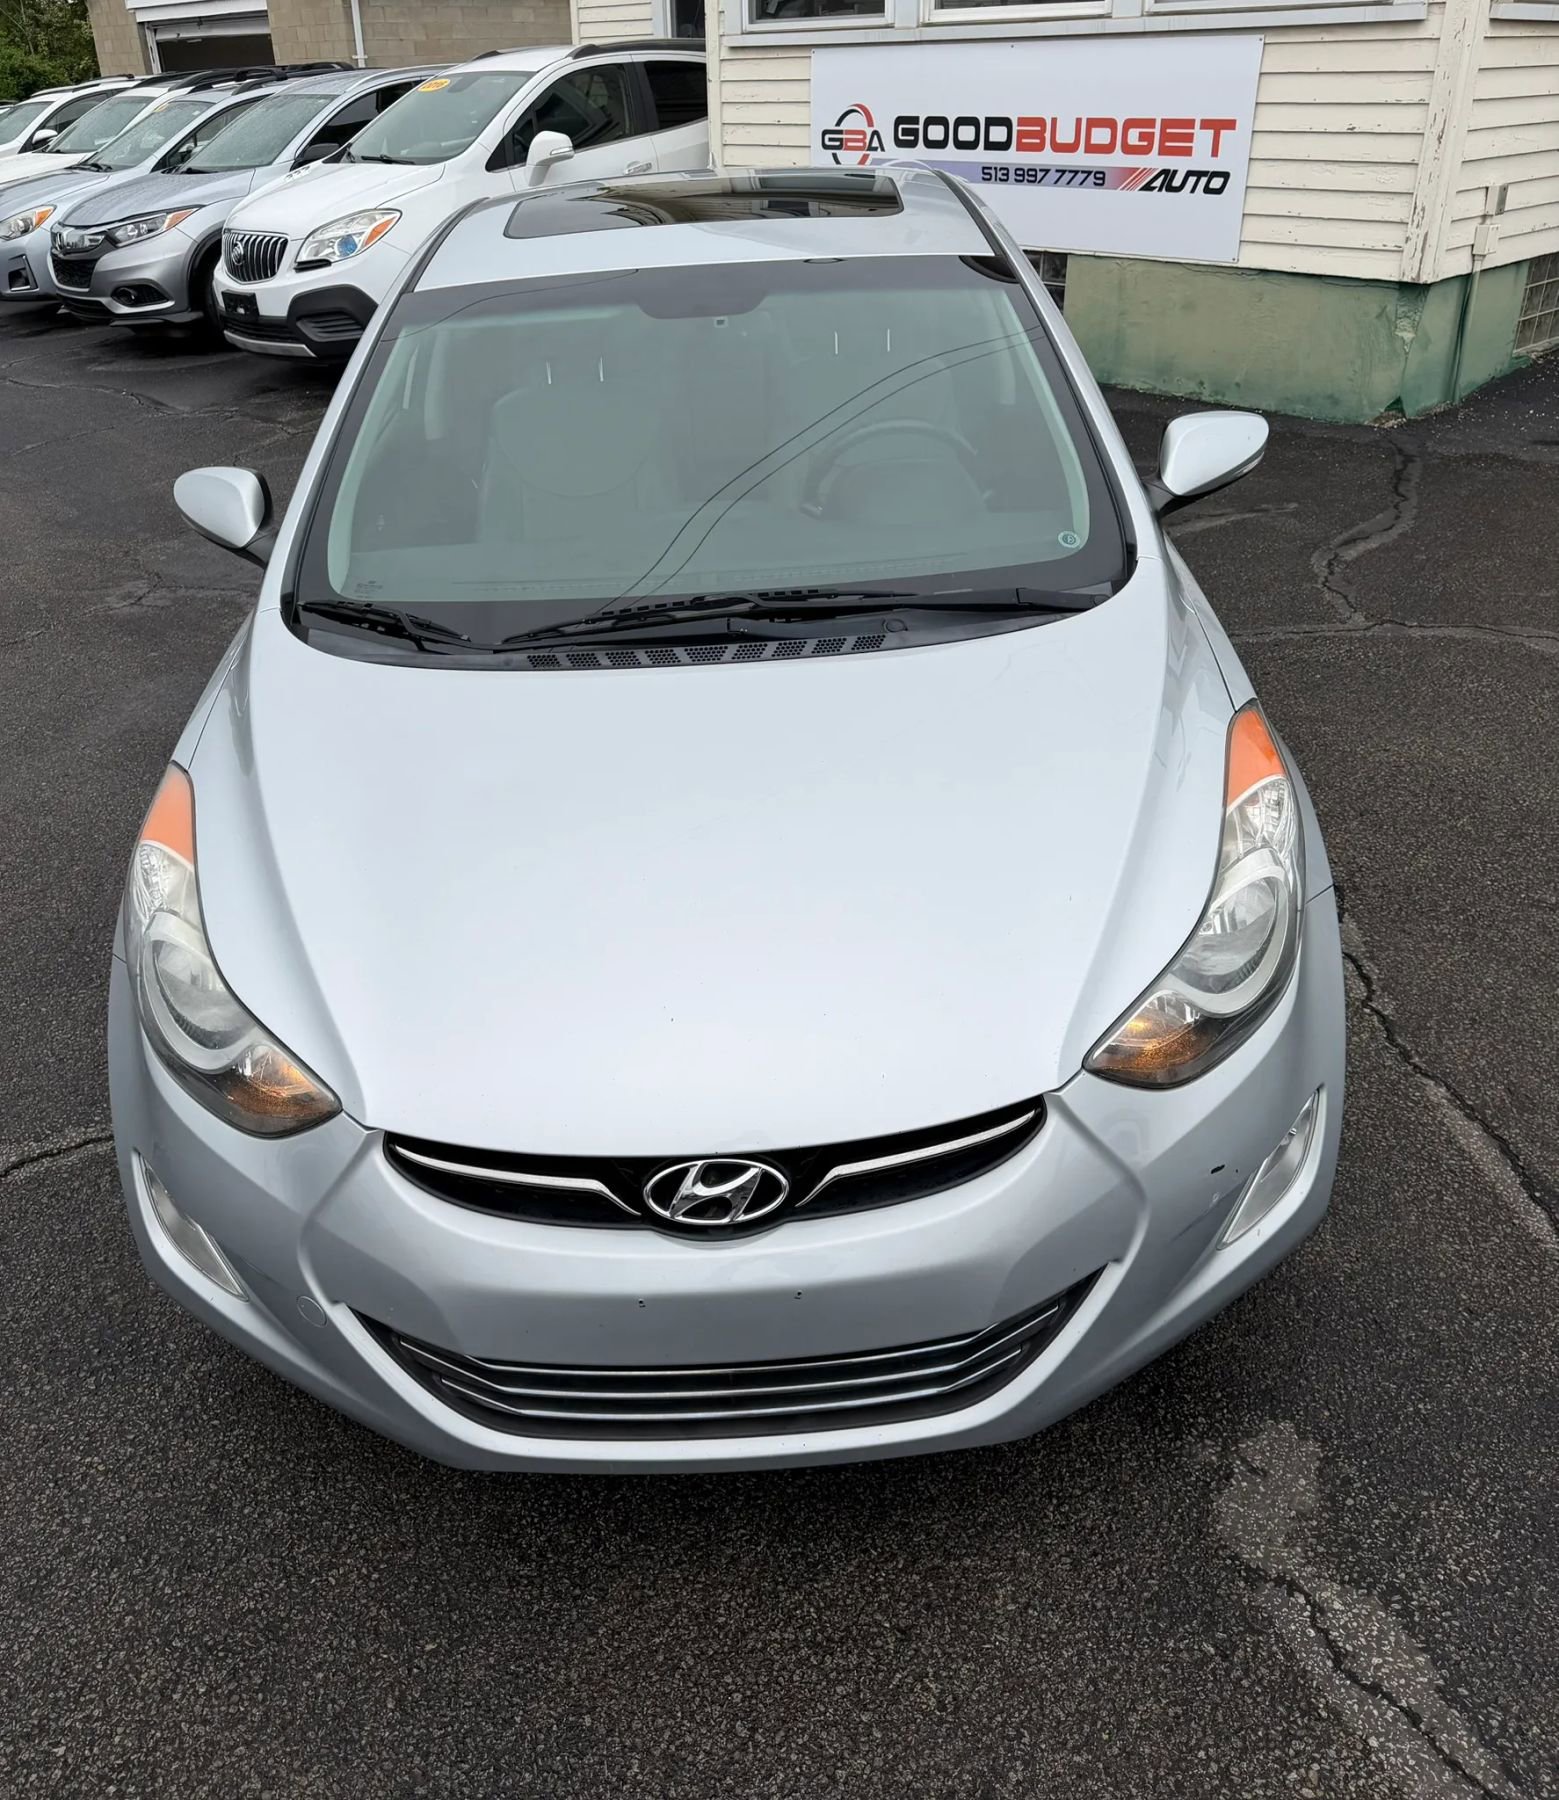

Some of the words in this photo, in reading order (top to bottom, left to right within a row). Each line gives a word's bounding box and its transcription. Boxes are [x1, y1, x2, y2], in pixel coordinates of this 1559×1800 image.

[821, 129, 886, 153] GBA
[981, 166, 1010, 183] 513
[1014, 167, 1052, 185] 997
[1053, 168, 1106, 187] 7779
[1138, 168, 1231, 196] AUTO
